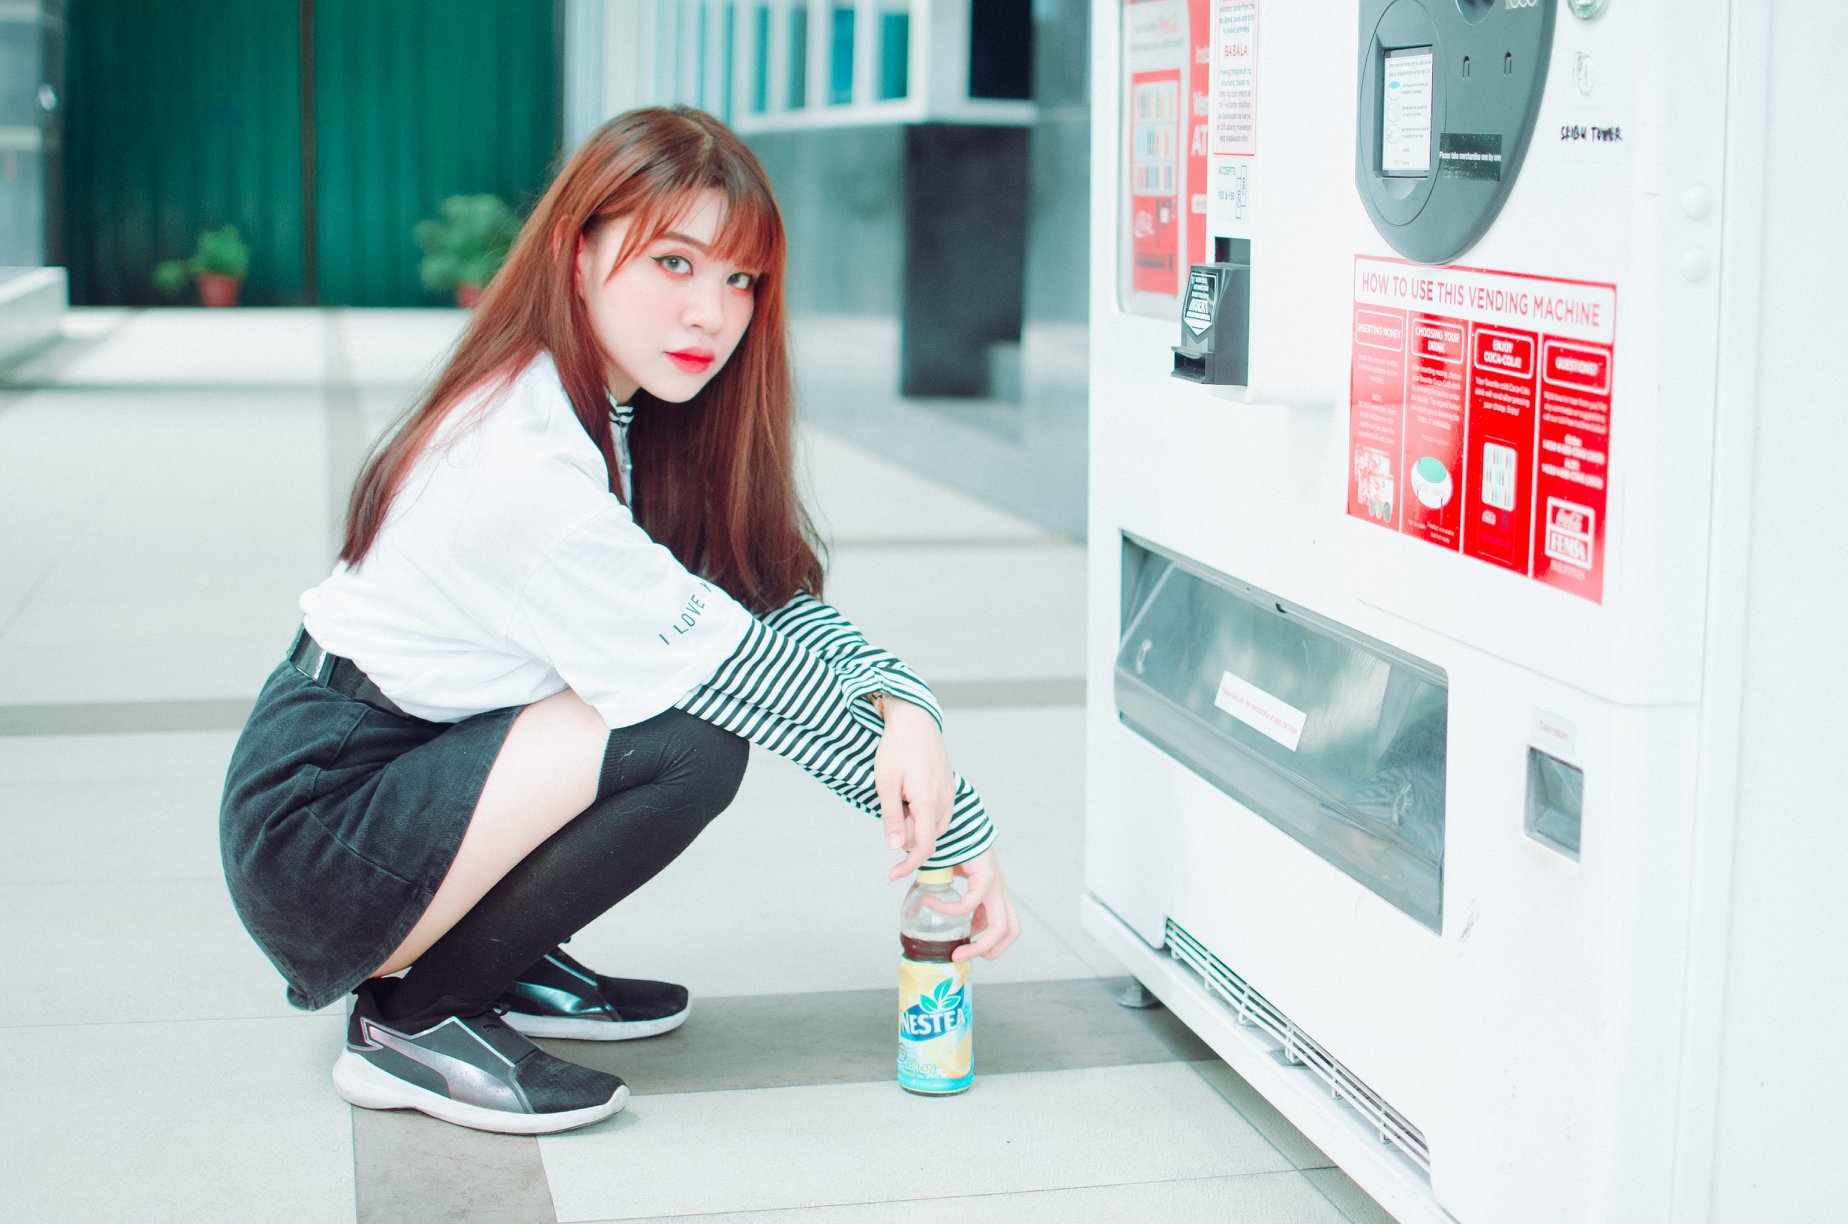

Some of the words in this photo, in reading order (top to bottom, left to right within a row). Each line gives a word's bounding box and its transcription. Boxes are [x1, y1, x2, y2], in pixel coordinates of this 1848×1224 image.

[1225, 44, 1248, 57] BABALA
[1591, 126, 1623, 142] TOWER
[1362, 271, 1389, 295] HOW
[1393, 276, 1407, 298] TO
[1411, 278, 1434, 301] USE
[1438, 281, 1464, 306] THIS
[1468, 286, 1528, 316] VENDING
[1533, 295, 1600, 327] MACHINE
[1358, 322, 1382, 336] INSERTING
[1383, 327, 1401, 339] MONEY
[1415, 326, 1443, 341] CHOOSING
[1443, 330, 1460, 343] YOUR
[1427, 340, 1445, 353] DRINK
[1492, 338, 1514, 353] ENJOY
[1483, 350, 1522, 369] COCA-COLA!
[659, 633, 670, 645] I
[673, 594, 705, 634] LOVE
[901, 1008, 966, 1036] NESTEA
